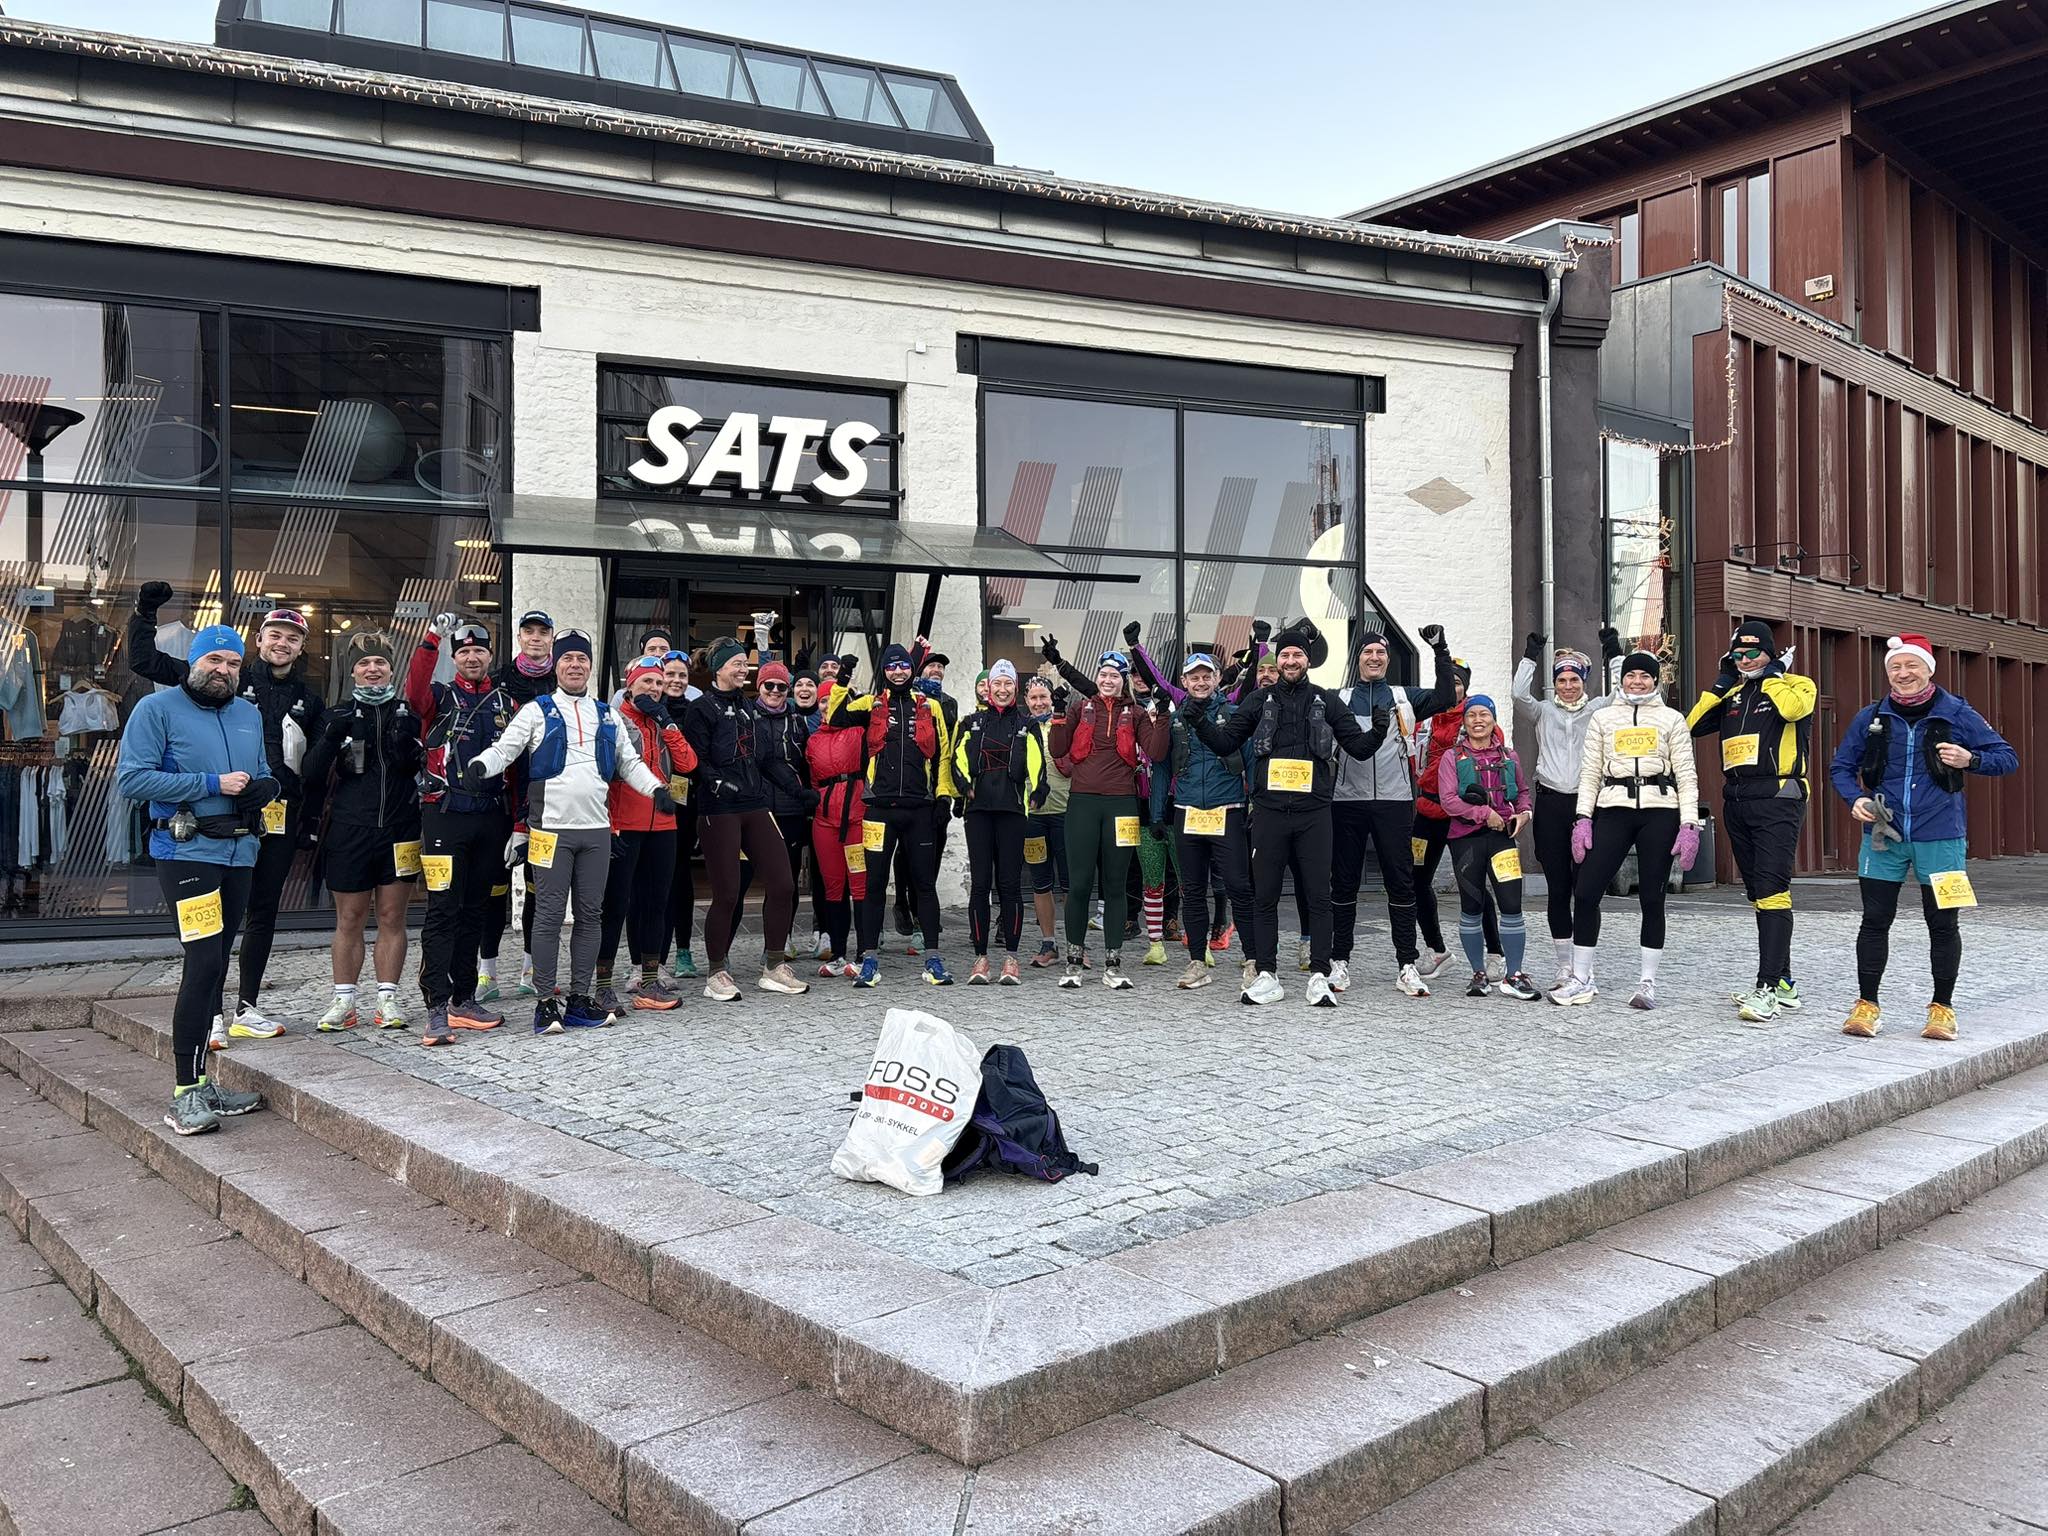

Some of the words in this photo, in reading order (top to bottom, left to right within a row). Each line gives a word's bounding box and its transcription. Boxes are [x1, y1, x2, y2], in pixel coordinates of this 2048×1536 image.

[627, 405, 881, 498] SATS
[1626, 736, 1644, 746] 040
[1281, 770, 1299, 779] 039
[1197, 816, 1213, 824] 007
[194, 906, 217, 923] 033
[868, 1060, 960, 1105] FOSS
[897, 1093, 949, 1118] sport
[887, 1119, 918, 1136] SYKKEL
